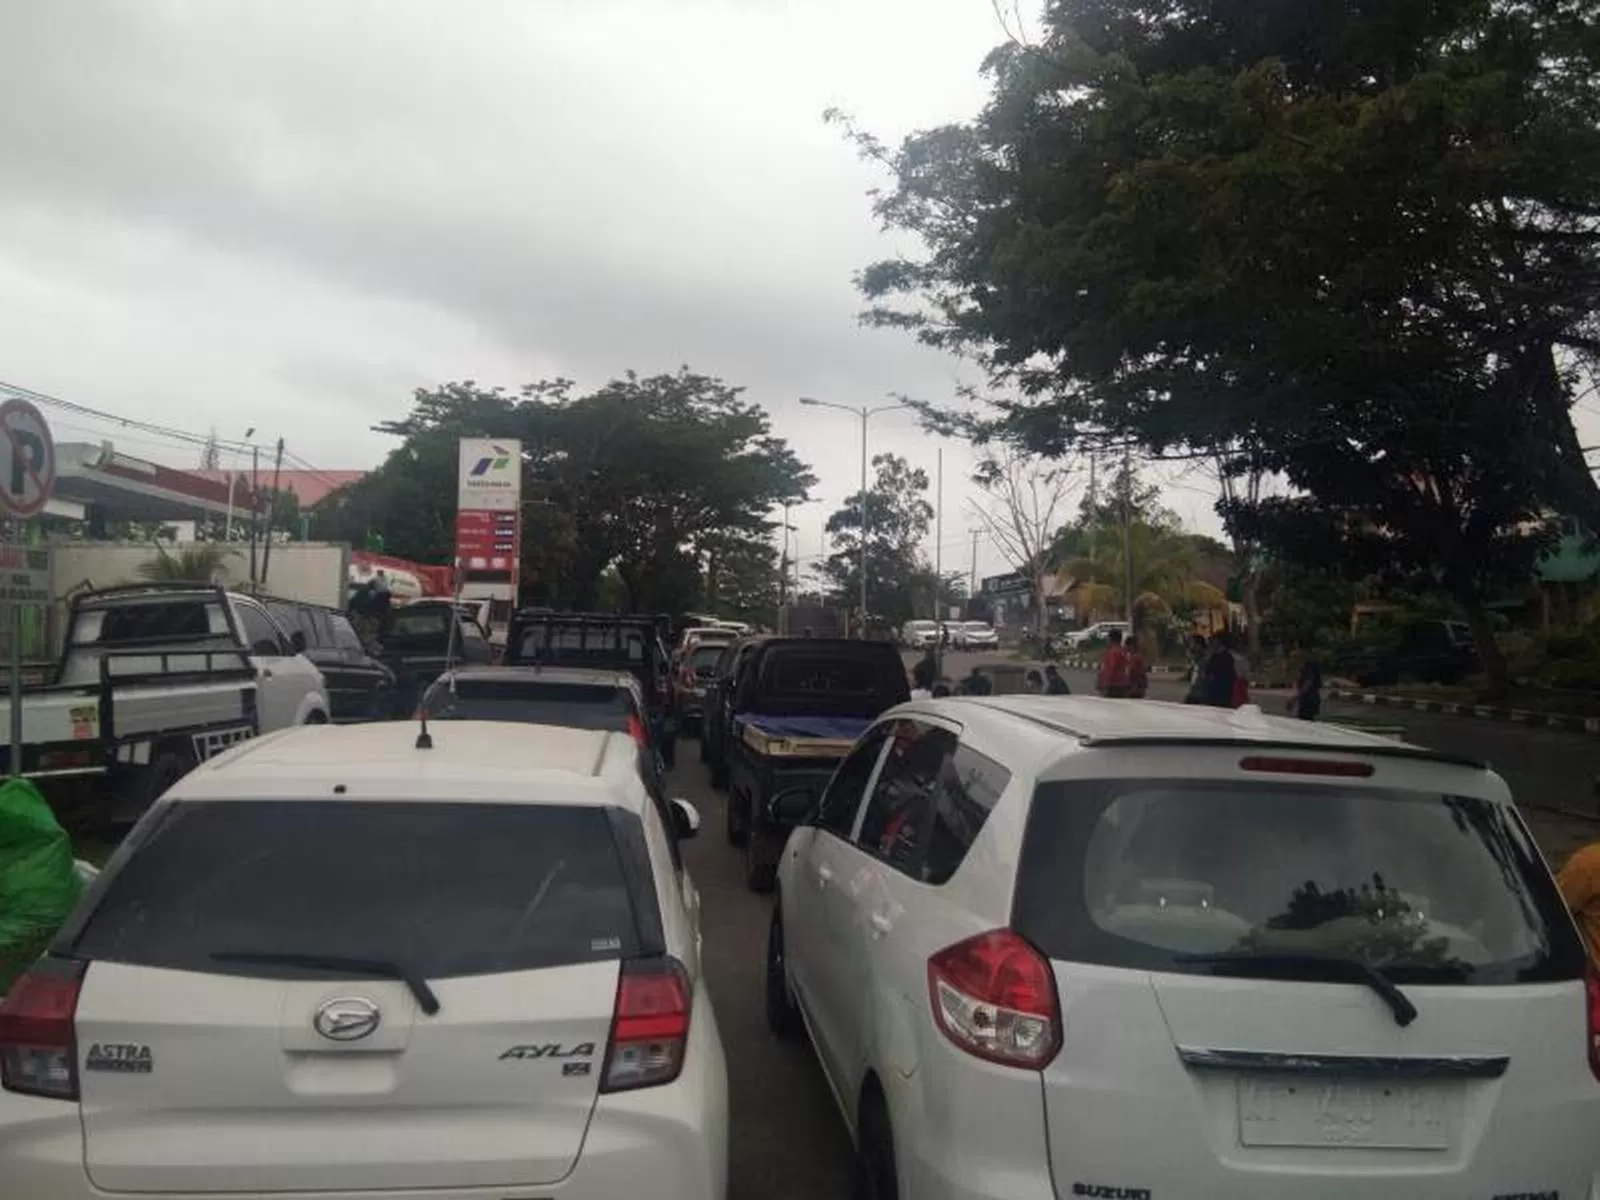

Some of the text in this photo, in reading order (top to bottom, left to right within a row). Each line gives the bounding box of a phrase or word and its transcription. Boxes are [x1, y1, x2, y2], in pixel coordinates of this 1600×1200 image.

[86, 1043, 152, 1060] ASTRA
[498, 1042, 597, 1060] AYLA
[1072, 1182, 1152, 1200] SUZUKI
